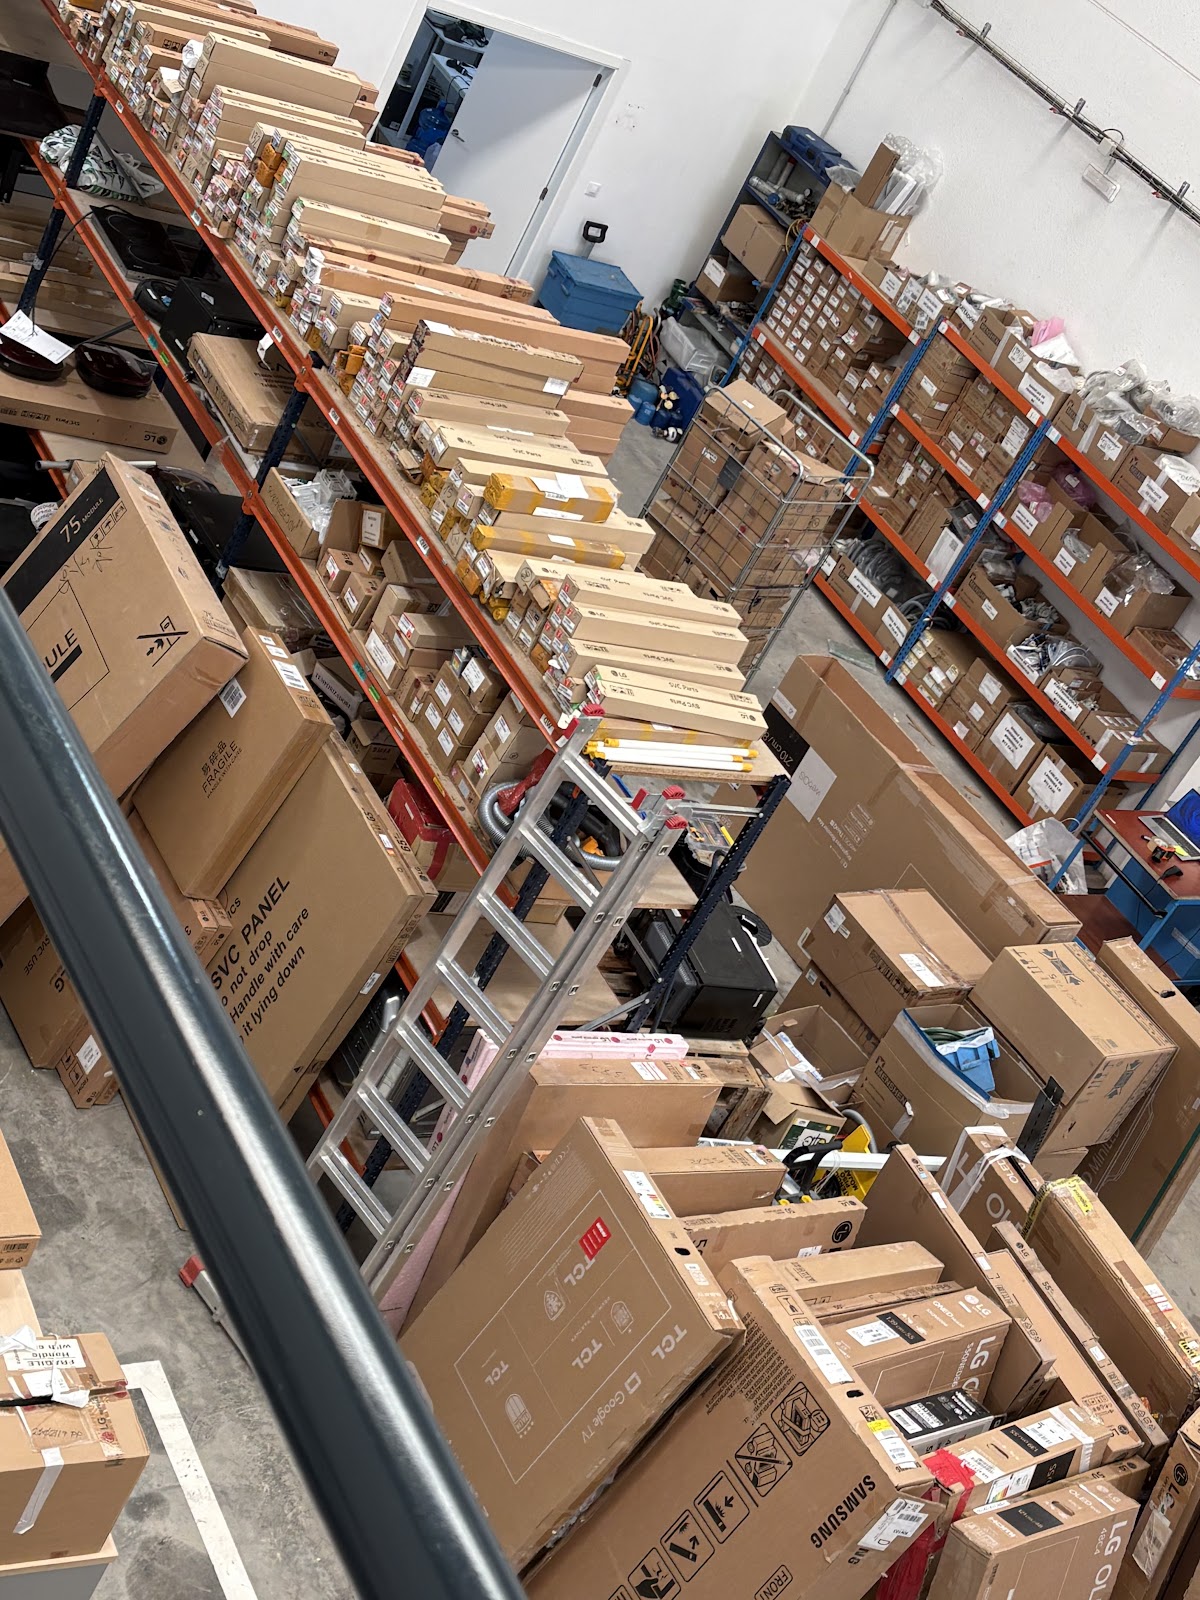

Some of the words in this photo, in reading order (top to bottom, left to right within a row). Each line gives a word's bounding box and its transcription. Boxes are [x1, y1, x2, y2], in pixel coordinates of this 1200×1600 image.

[143, 434, 157, 442] LG
[60, 515, 82, 543] 75
[81, 497, 104, 525] MODULE
[198, 739, 241, 792] FRAGILE
[780, 752, 793, 766] 210
[212, 945, 241, 990] SVC
[241, 877, 291, 946] PANEL
[24, 954, 37, 976] USE
[230, 967, 248, 994] not
[249, 930, 273, 966] drop
[230, 975, 265, 1023] Handle
[264, 941, 287, 976] with
[286, 907, 309, 943] care
[244, 1023, 253, 1036] it
[251, 987, 279, 1025] lying
[277, 945, 306, 989] down
[76, 1078, 89, 1095] FRONT
[872, 1064, 908, 1107] MENSHEN
[1022, 1247, 1029, 1257] LG
[563, 1256, 596, 1288] TCL
[976, 1301, 992, 1317] LG
[571, 1338, 602, 1370] TCL
[650, 1324, 687, 1361] TCL
[969, 1335, 997, 1375] LG
[484, 1360, 509, 1386] TCL
[99, 1417, 108, 1431] LG
[593, 1389, 625, 1428] Google
[581, 1423, 604, 1444] TV
[810, 1474, 876, 1549] SAMSUNG
[1069, 1488, 1087, 1503] OLED
[1105, 1492, 1122, 1503] LG
[988, 1516, 1017, 1539] HDMI
[1104, 1519, 1128, 1556] LG
